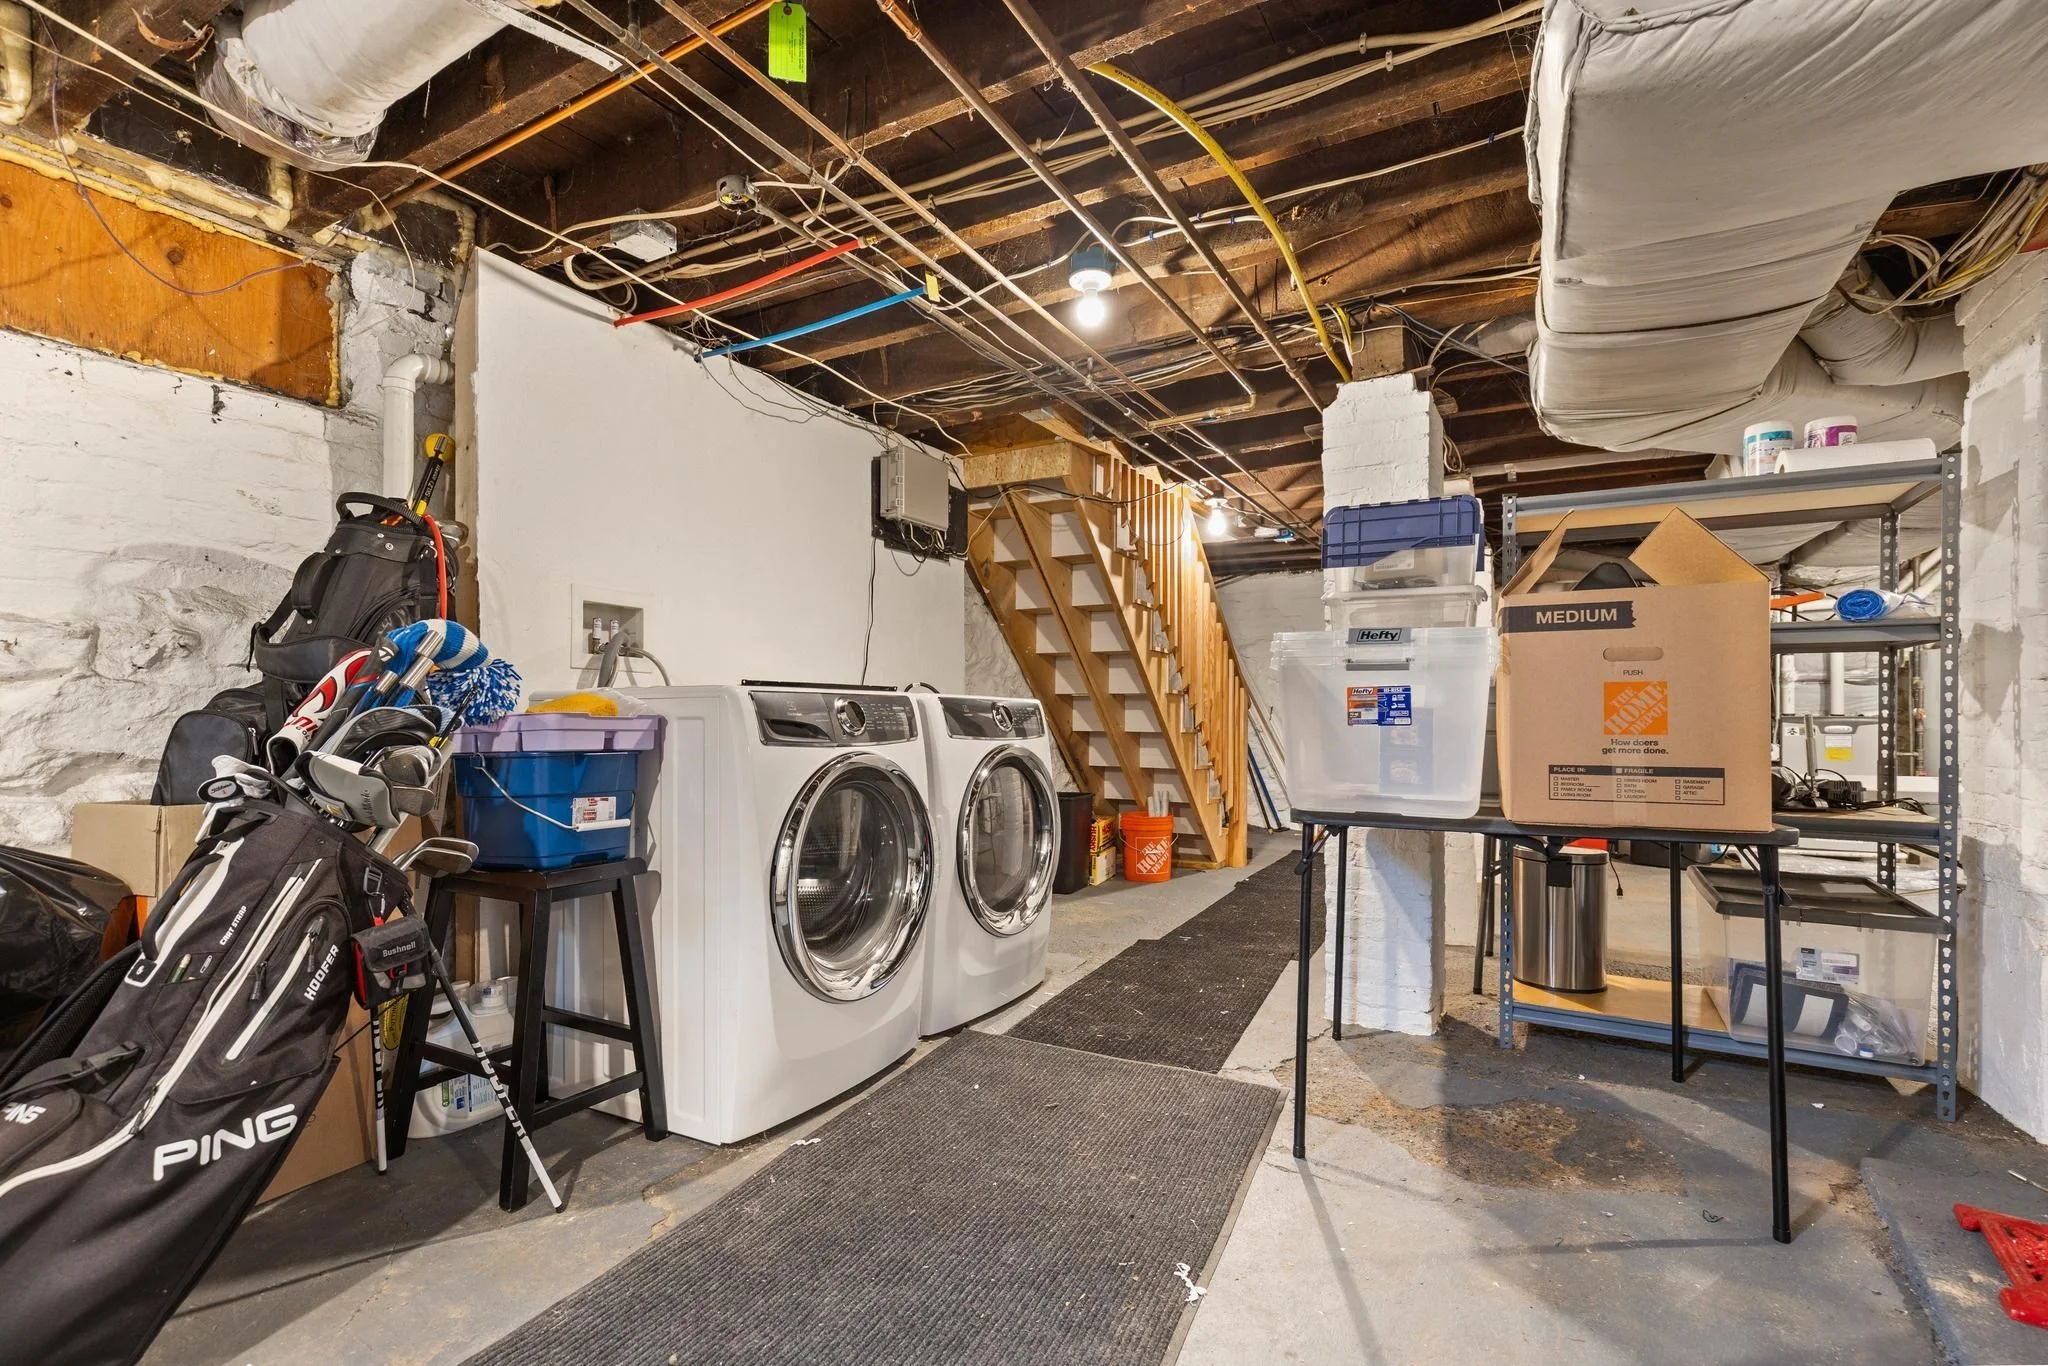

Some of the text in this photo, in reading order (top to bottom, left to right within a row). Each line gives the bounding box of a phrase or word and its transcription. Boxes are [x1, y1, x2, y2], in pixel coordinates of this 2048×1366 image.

[1536, 608, 1617, 625] MEDIUM
[1360, 631, 1398, 641] Hefty
[1604, 681, 1667, 734] HOME
[1609, 686, 1635, 708] THE
[1630, 702, 1667, 734] DEPOT
[1601, 747, 1617, 755] get
[1610, 738, 1659, 746] How doers
[1137, 838, 1171, 874] HOME
[1151, 851, 1169, 874] DEPOT
[220, 905, 247, 946] CART STRAP
[382, 941, 416, 958] Bushnell
[304, 944, 339, 1001] HOOFER
[2, 1102, 47, 1125] PING
[153, 1103, 298, 1182] PING
